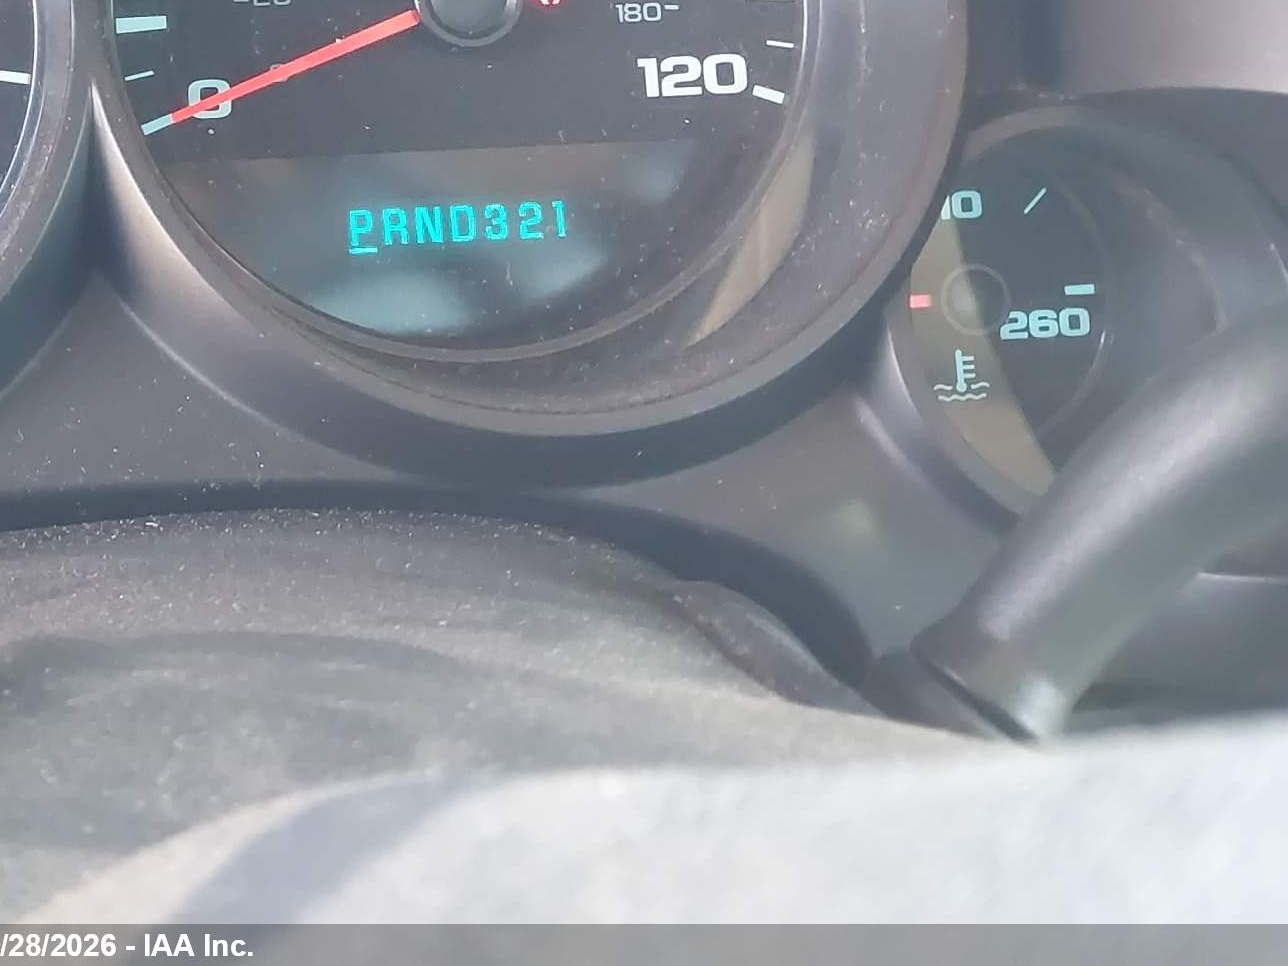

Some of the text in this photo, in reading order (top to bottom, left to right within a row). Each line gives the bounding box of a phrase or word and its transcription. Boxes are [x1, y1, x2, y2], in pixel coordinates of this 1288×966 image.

[615, 1, 662, 23] 180
[637, 53, 749, 98] 120
[187, 79, 233, 119] 0
[1000, 307, 1091, 340] 260
